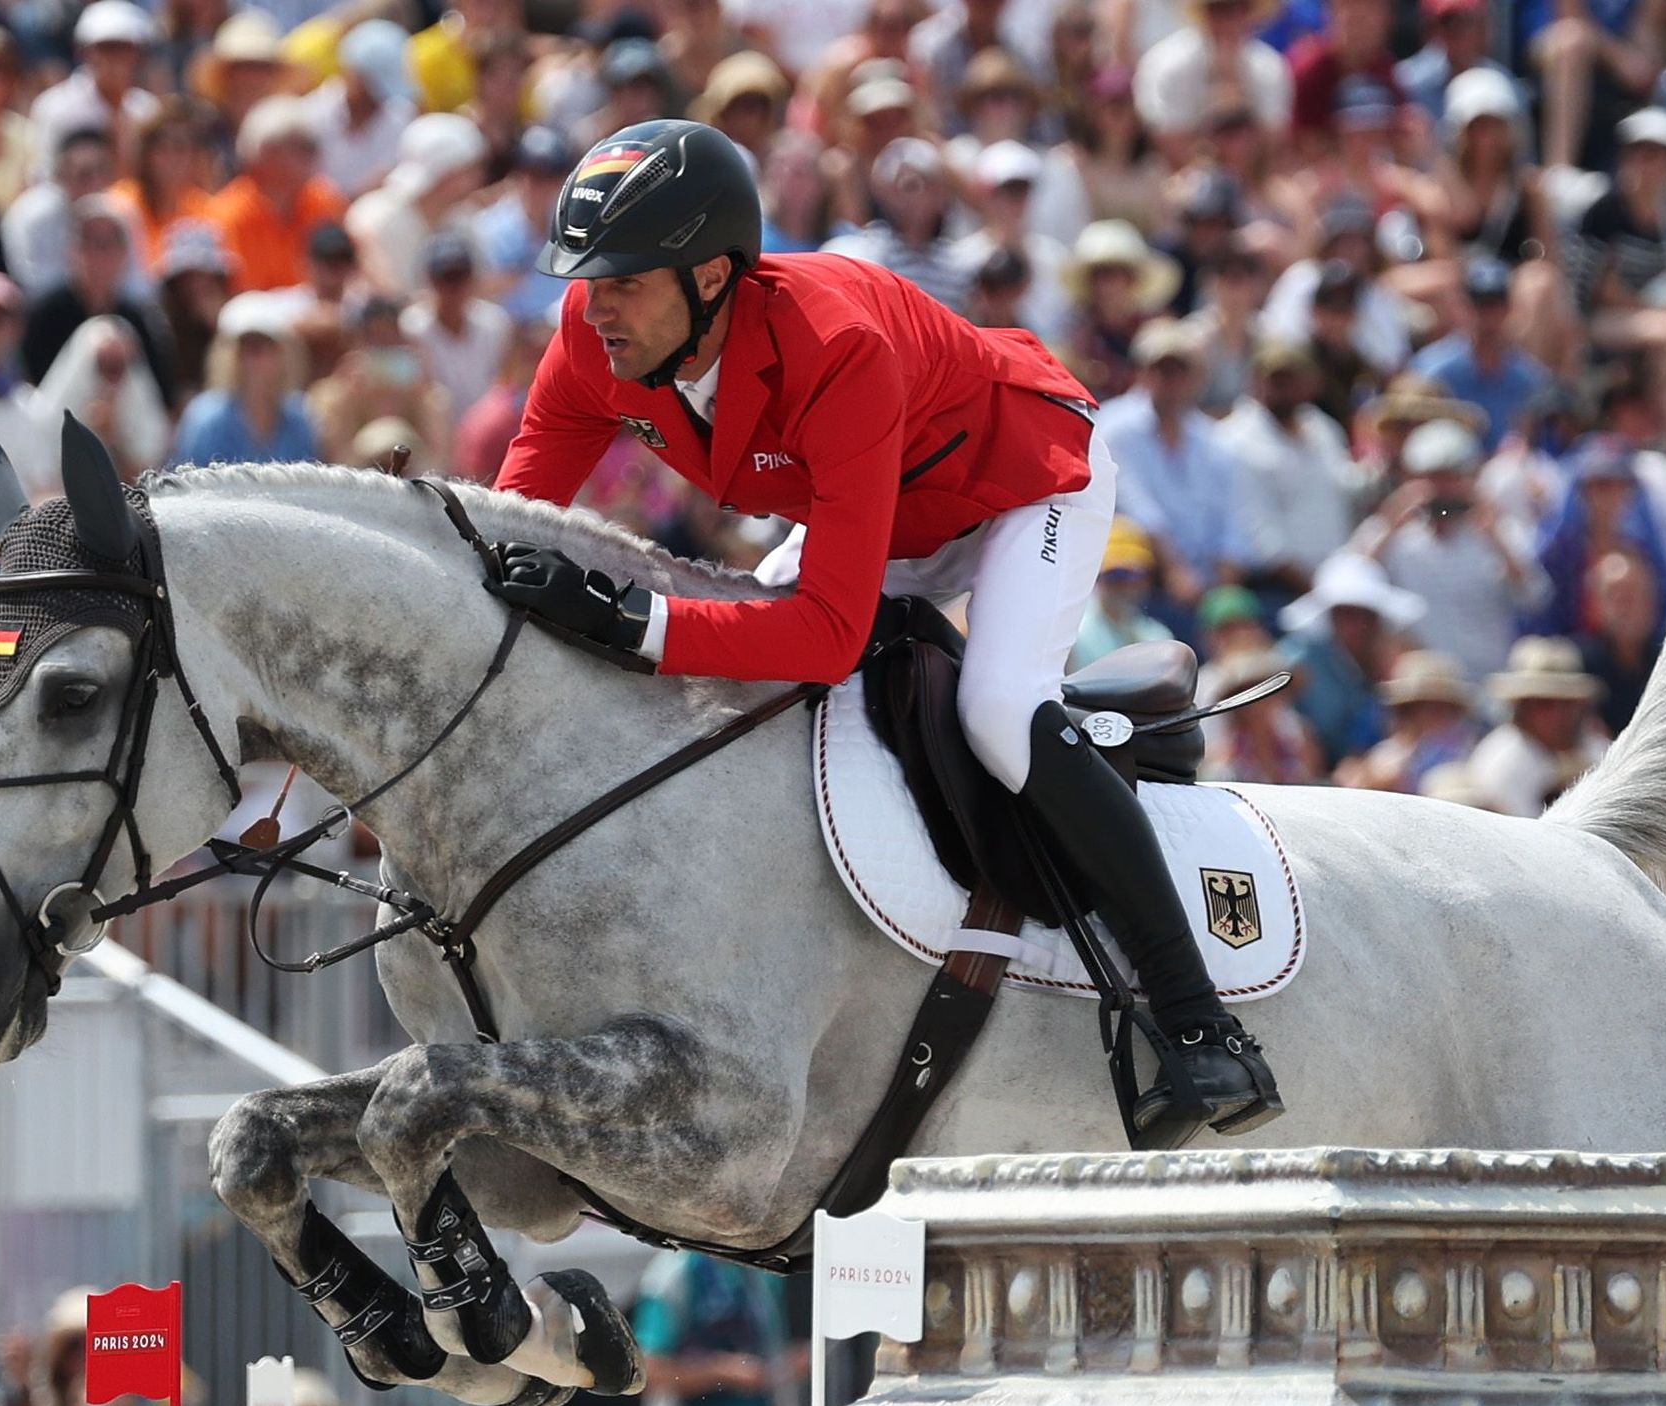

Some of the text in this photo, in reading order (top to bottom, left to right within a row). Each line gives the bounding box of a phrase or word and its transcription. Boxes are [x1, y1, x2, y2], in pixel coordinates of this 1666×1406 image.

[571, 187, 605, 203] uvex
[1093, 717, 1113, 740] 339
[829, 1266, 912, 1285] PARIS 2024
[94, 1333, 165, 1351] PARIS 2024
